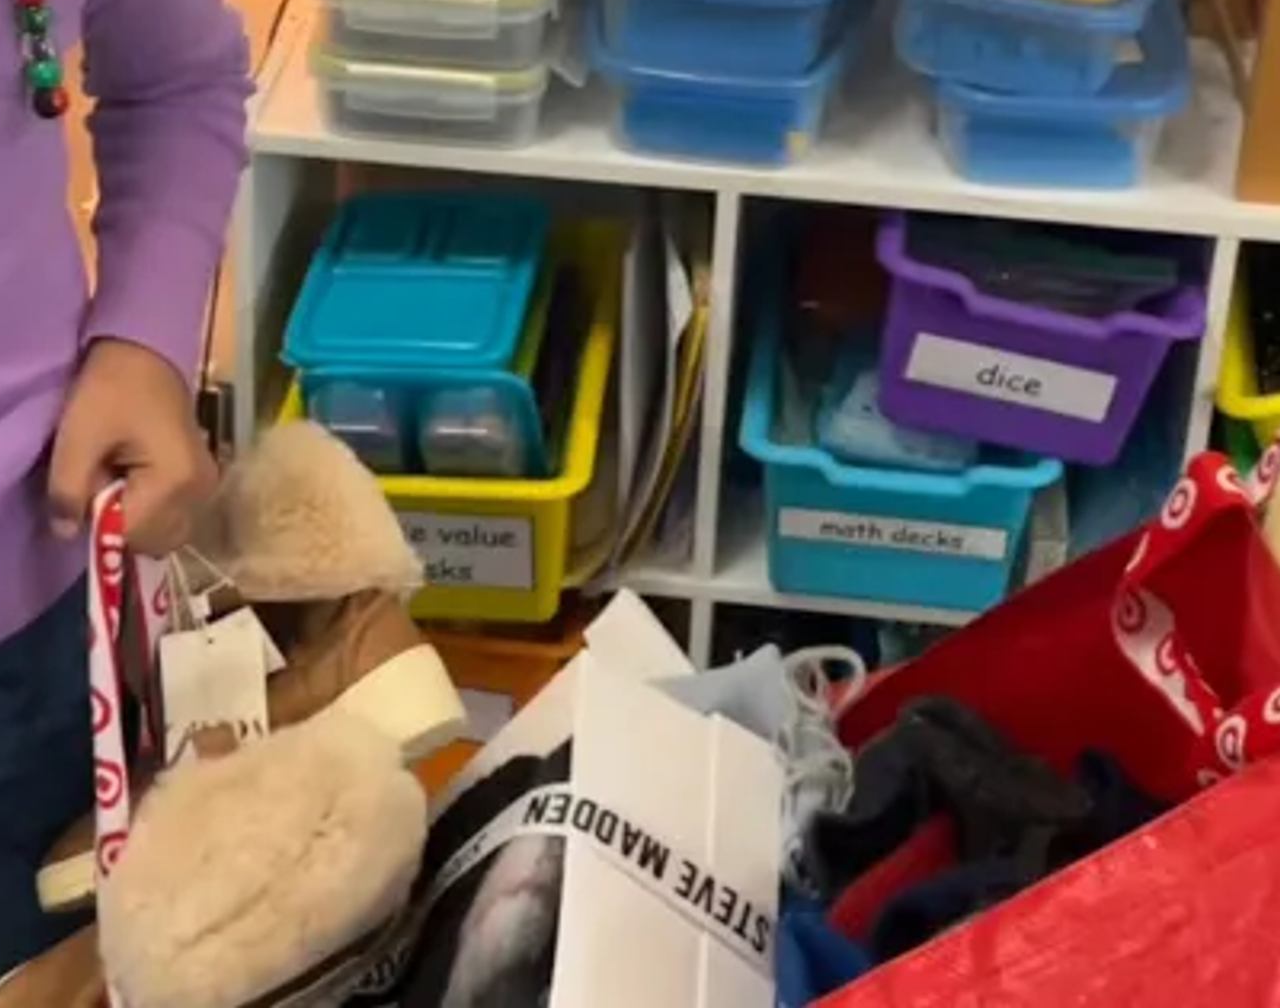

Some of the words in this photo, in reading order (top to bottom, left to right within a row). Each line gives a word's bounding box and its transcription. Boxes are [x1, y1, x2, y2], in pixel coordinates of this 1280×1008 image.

[975, 363, 1043, 398] dice
[438, 523, 517, 548] value
[820, 521, 883, 540] math
[891, 526, 966, 551] decks
[523, 793, 671, 879] MADDEN
[674, 860, 771, 954] STEVE
